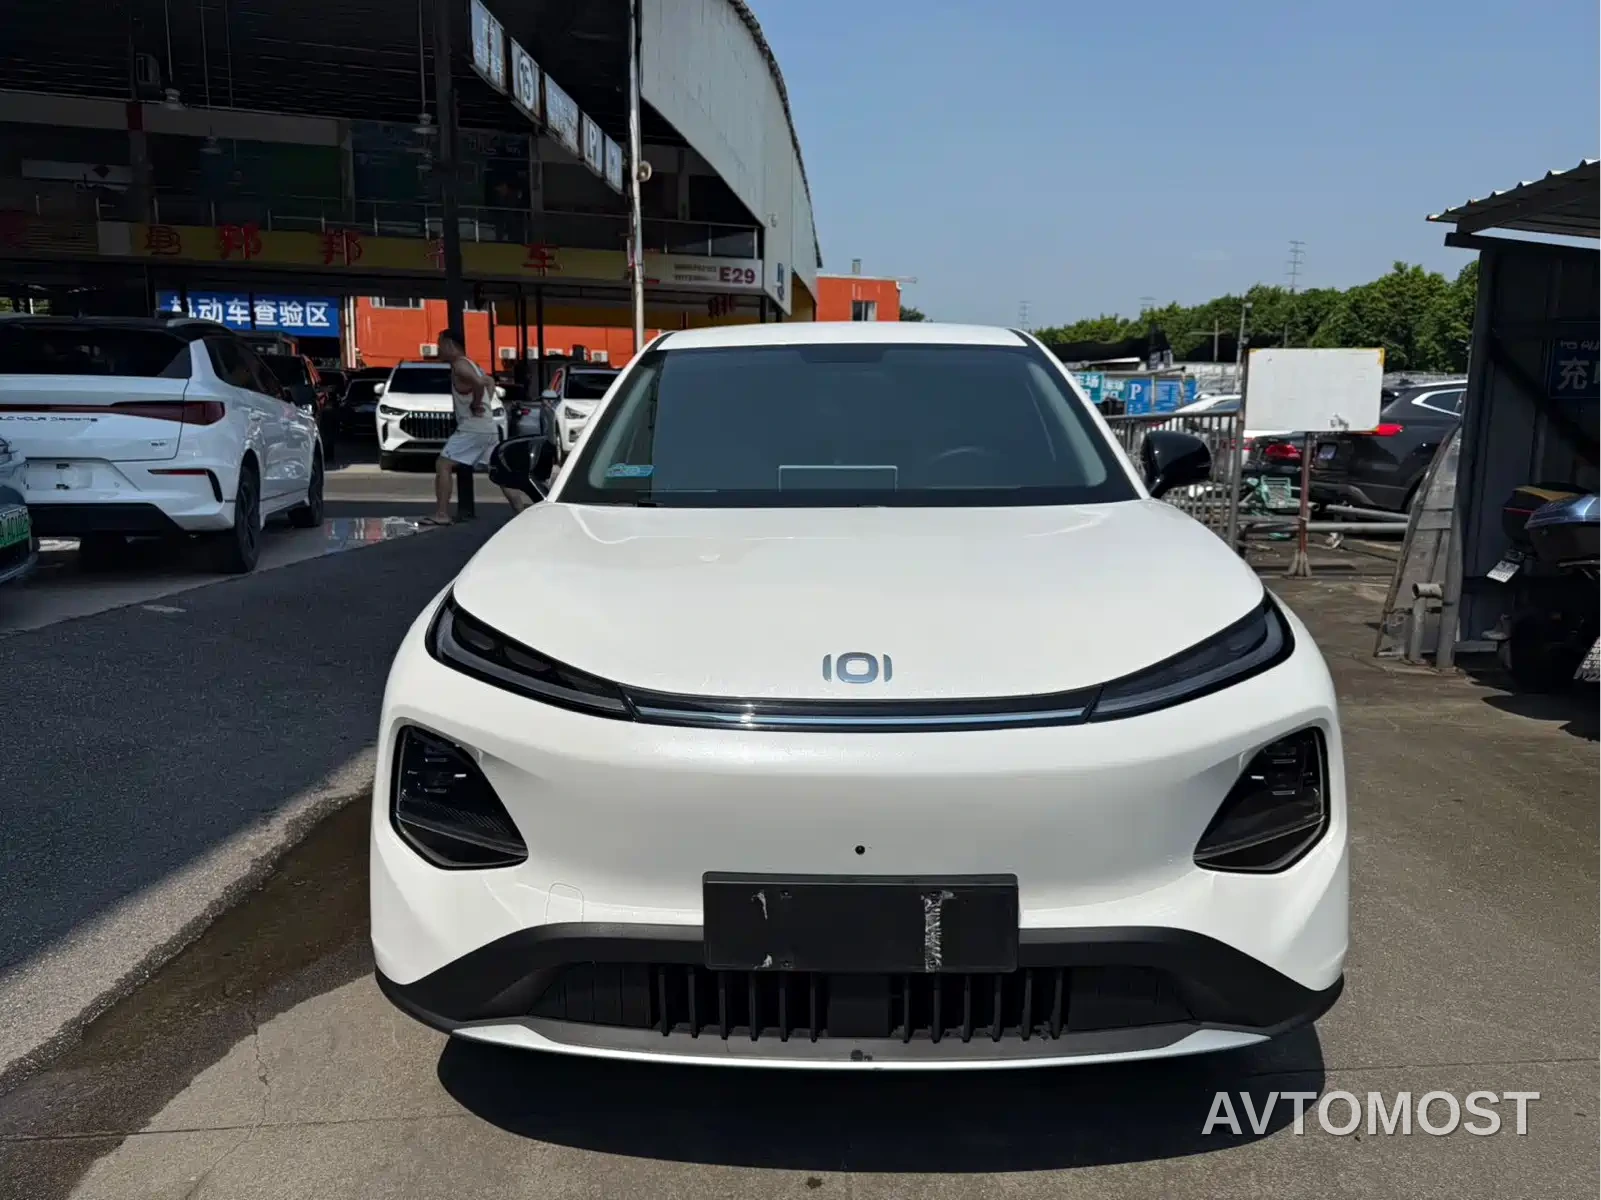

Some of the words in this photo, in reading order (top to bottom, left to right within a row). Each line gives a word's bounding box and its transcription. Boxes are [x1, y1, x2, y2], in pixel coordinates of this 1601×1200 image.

[719, 266, 756, 285] E29
[1556, 355, 1600, 391] 充
[1128, 383, 1142, 400] P
